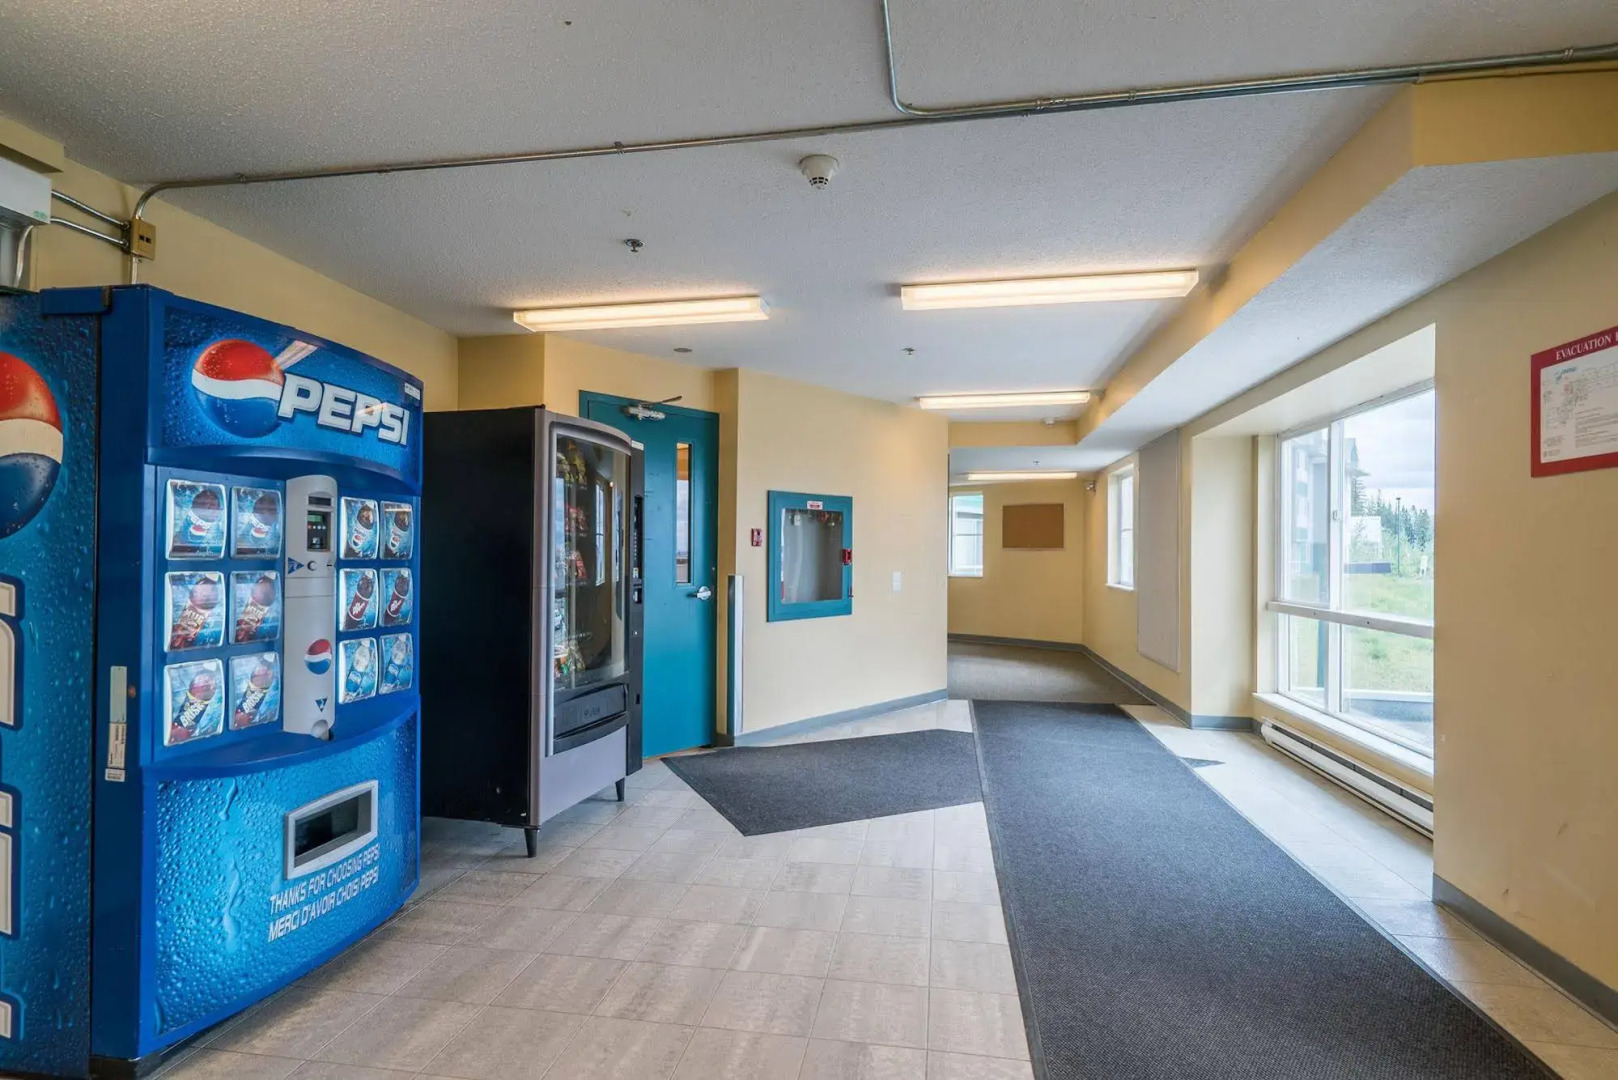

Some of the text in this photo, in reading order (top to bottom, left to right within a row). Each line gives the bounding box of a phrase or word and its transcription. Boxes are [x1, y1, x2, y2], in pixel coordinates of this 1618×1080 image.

[1556, 335, 1612, 360] EVACUATION
[277, 372, 411, 446] PEPSI
[268, 910, 301, 943] MERCI
[301, 891, 336, 926] D'AVOIR
[336, 877, 360, 906] CHOISI
[269, 881, 307, 915] THANKS
[308, 873, 326, 898] FOR
[326, 853, 364, 888] CHOOSING
